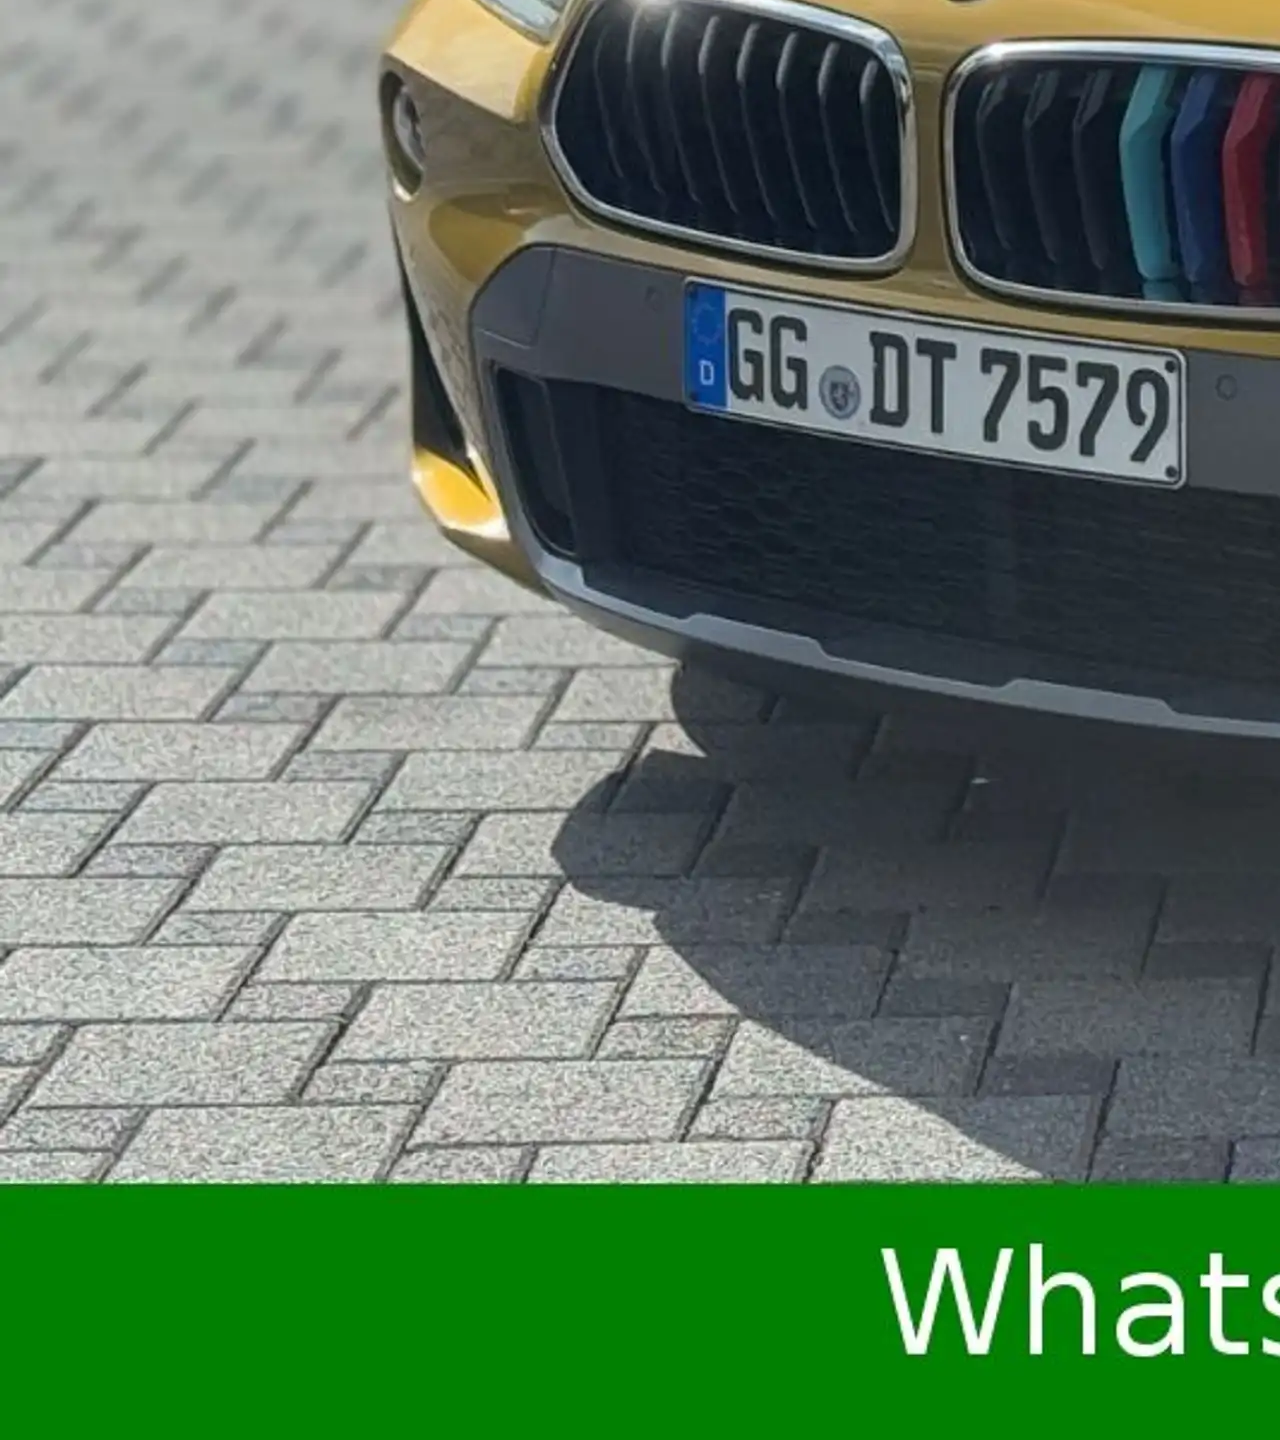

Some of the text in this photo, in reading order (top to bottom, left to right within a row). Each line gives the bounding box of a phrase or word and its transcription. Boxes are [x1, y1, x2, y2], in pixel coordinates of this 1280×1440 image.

[699, 359, 715, 386] D
[727, 307, 1170, 464] GG DT 7579
